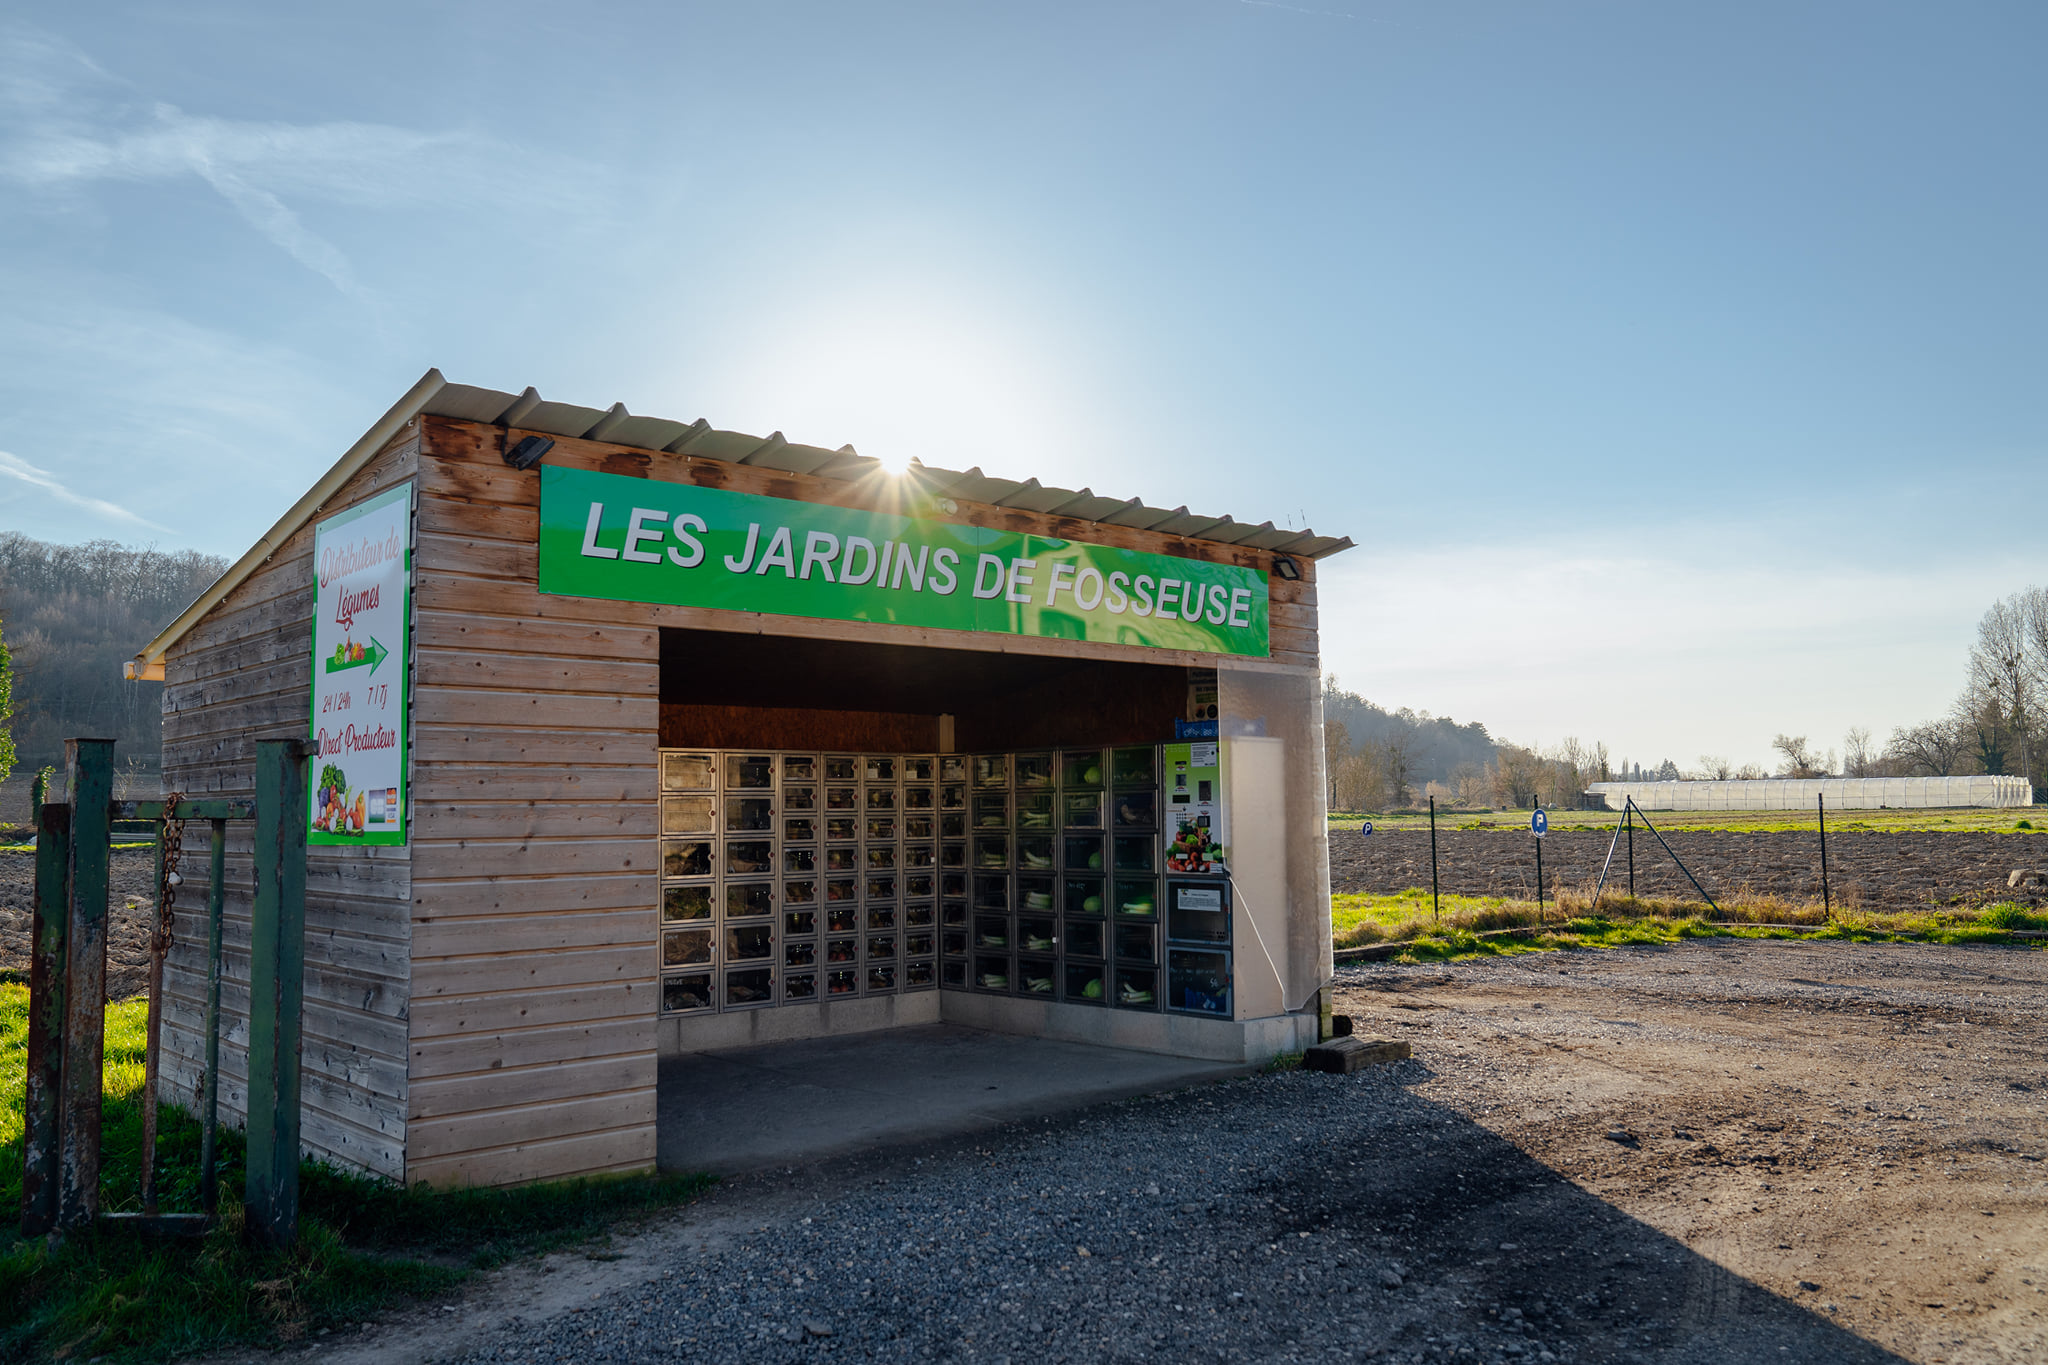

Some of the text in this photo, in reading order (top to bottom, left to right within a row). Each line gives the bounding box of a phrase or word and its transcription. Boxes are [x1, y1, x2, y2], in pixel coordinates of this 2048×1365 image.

[320, 525, 400, 588] Distributeur de
[581, 502, 1252, 628] LES JARDINS DE FOSSEUSE
[336, 584, 380, 631] Légumes
[318, 723, 396, 760] Direct Producteur
[1536, 814, 1544, 827] P
